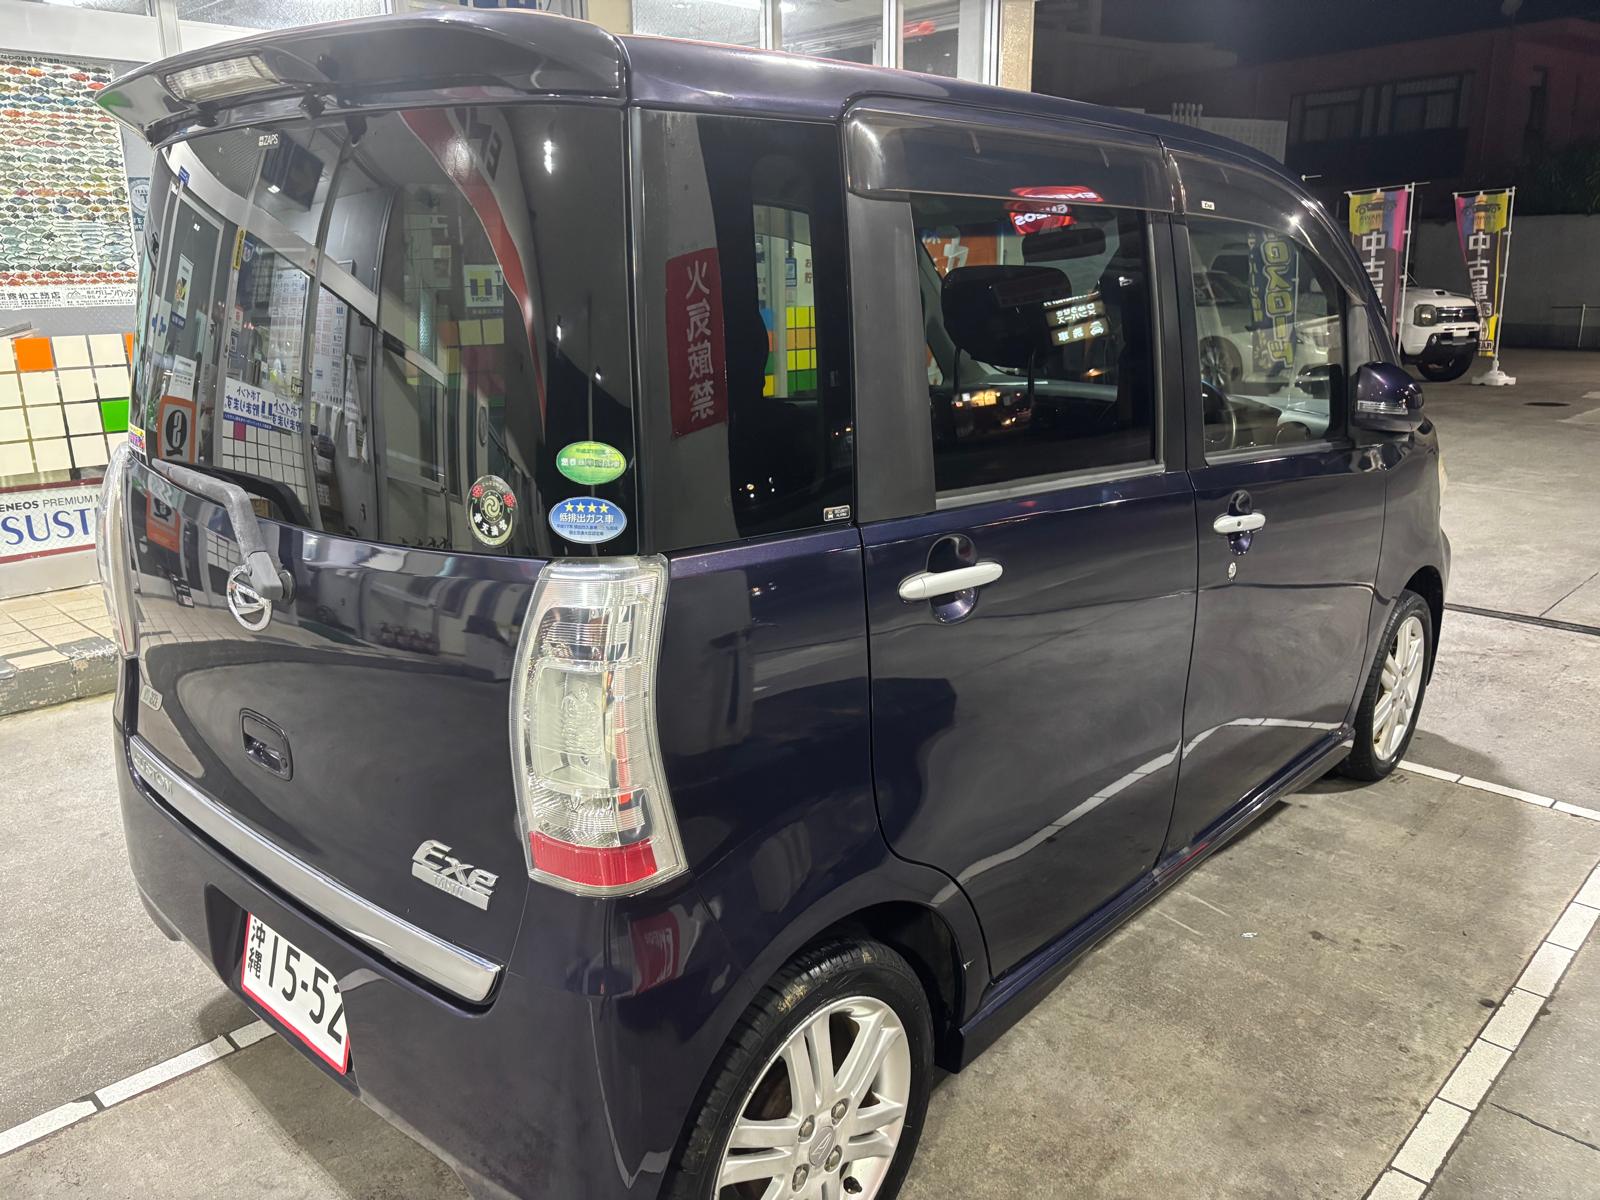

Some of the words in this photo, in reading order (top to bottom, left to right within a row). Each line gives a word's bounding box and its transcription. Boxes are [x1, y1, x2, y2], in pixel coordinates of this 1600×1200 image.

[0, 500, 39, 513] ENEOS
[43, 495, 93, 508] PREMIUM
[1, 508, 97, 545] SUST
[559, 512, 614, 524] 低排出ガス車
[412, 840, 499, 896] Exe
